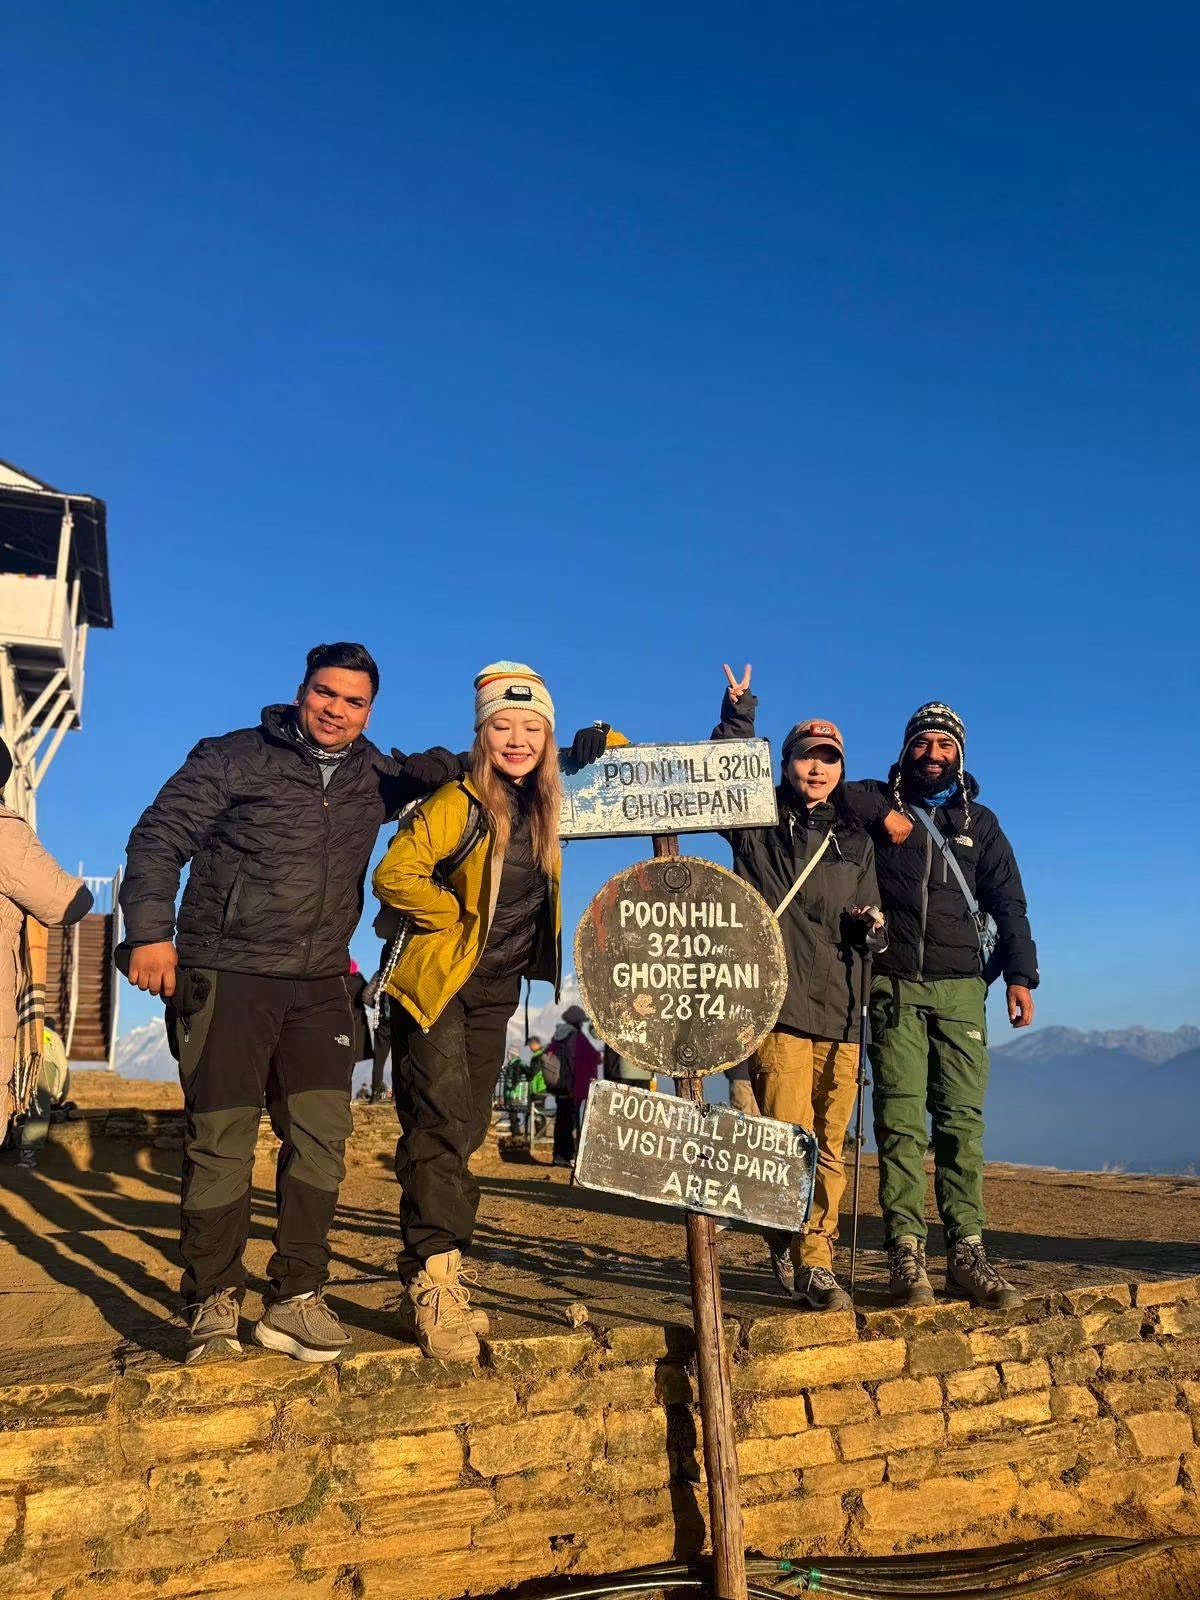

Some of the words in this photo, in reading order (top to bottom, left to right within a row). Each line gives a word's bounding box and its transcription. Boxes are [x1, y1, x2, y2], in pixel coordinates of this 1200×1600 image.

[604, 758, 715, 788] POONHILL
[622, 788, 749, 820] GHOREPANI
[620, 899, 744, 928] POONHILL
[612, 962, 760, 992] GHOREPANI
[659, 993, 726, 1021] 2874
[608, 1091, 723, 1141] POONHILL
[731, 1118, 808, 1159] PUBLIC
[616, 1125, 731, 1173] VISITORS
[733, 1153, 791, 1187] PARK
[661, 1171, 742, 1210] AREA
